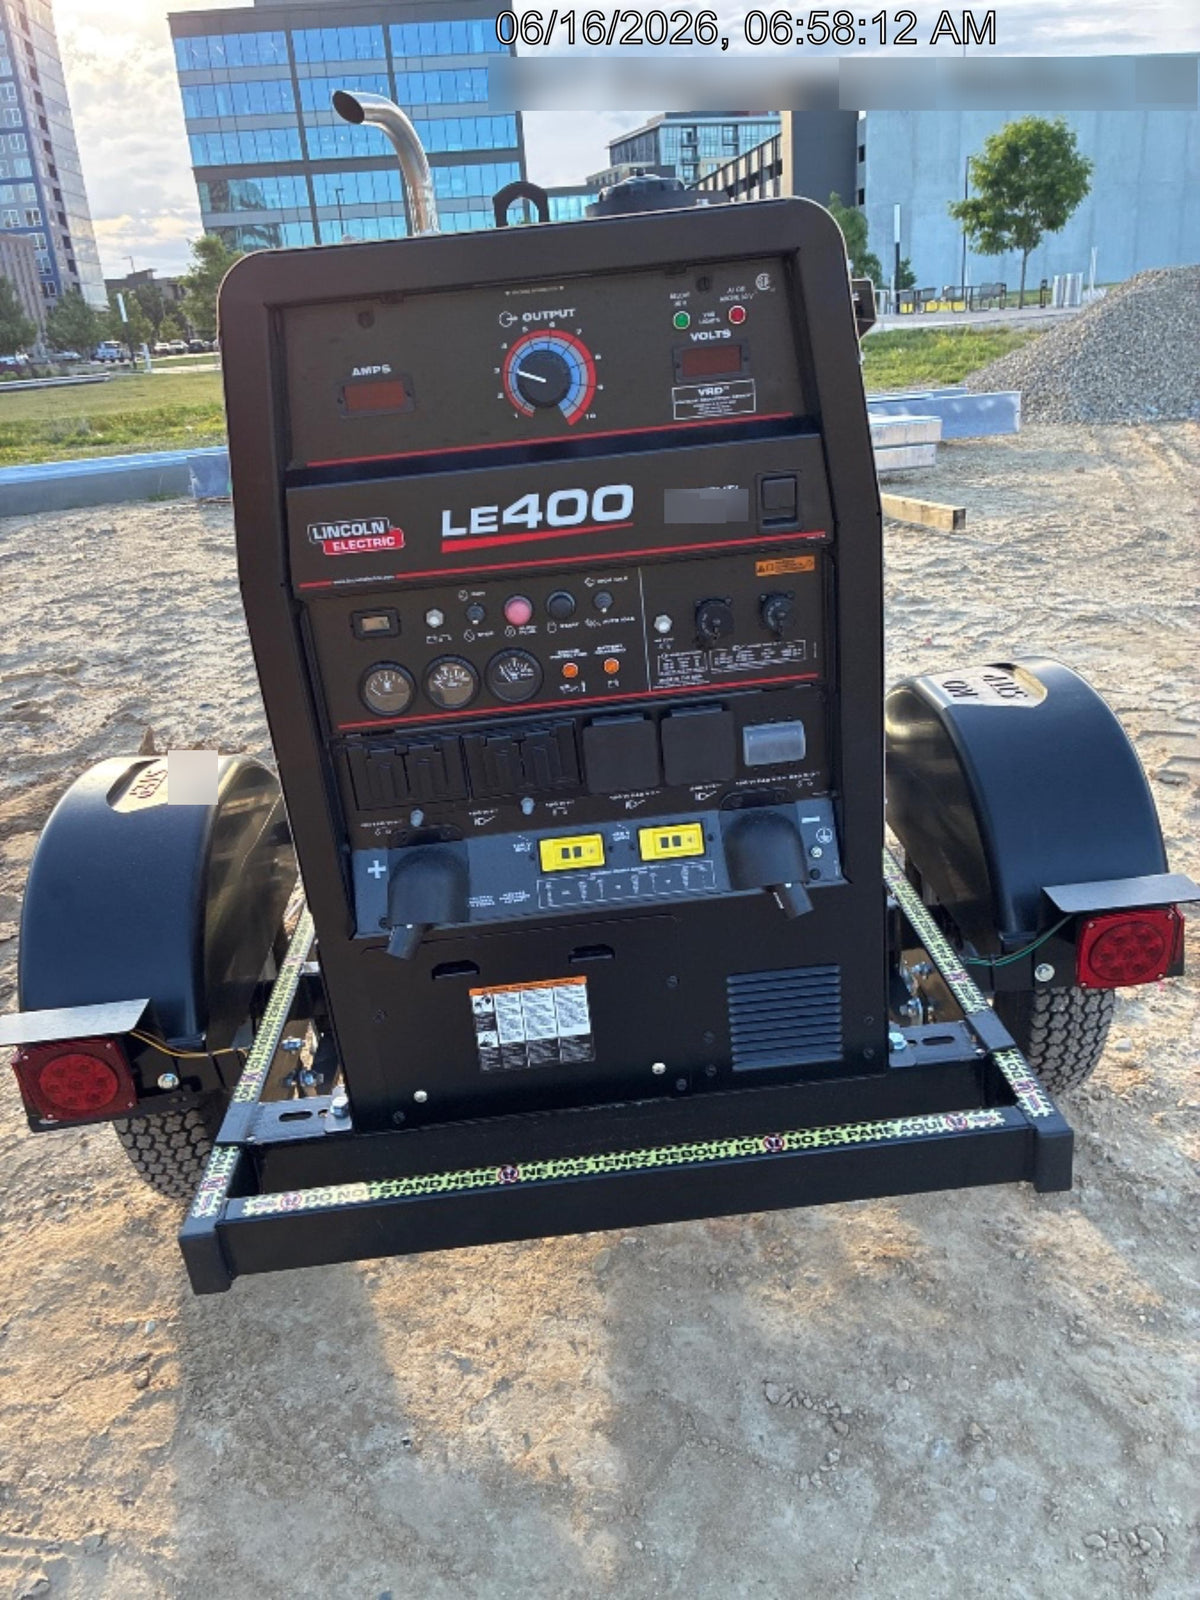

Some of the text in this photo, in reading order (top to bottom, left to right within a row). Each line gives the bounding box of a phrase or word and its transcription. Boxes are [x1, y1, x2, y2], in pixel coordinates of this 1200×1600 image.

[522, 308, 577, 322] OUTPUT
[690, 328, 732, 342] VOLTS
[352, 364, 392, 376] AMPS
[442, 484, 634, 537] LE400
[312, 520, 385, 540] LINCOLN
[332, 536, 395, 552] ELECTRIC
[305, 1120, 944, 1203] DO NOT STAND HERE NE PAS TENEZ DEBOUT ICI NO SE PARE AQUI
